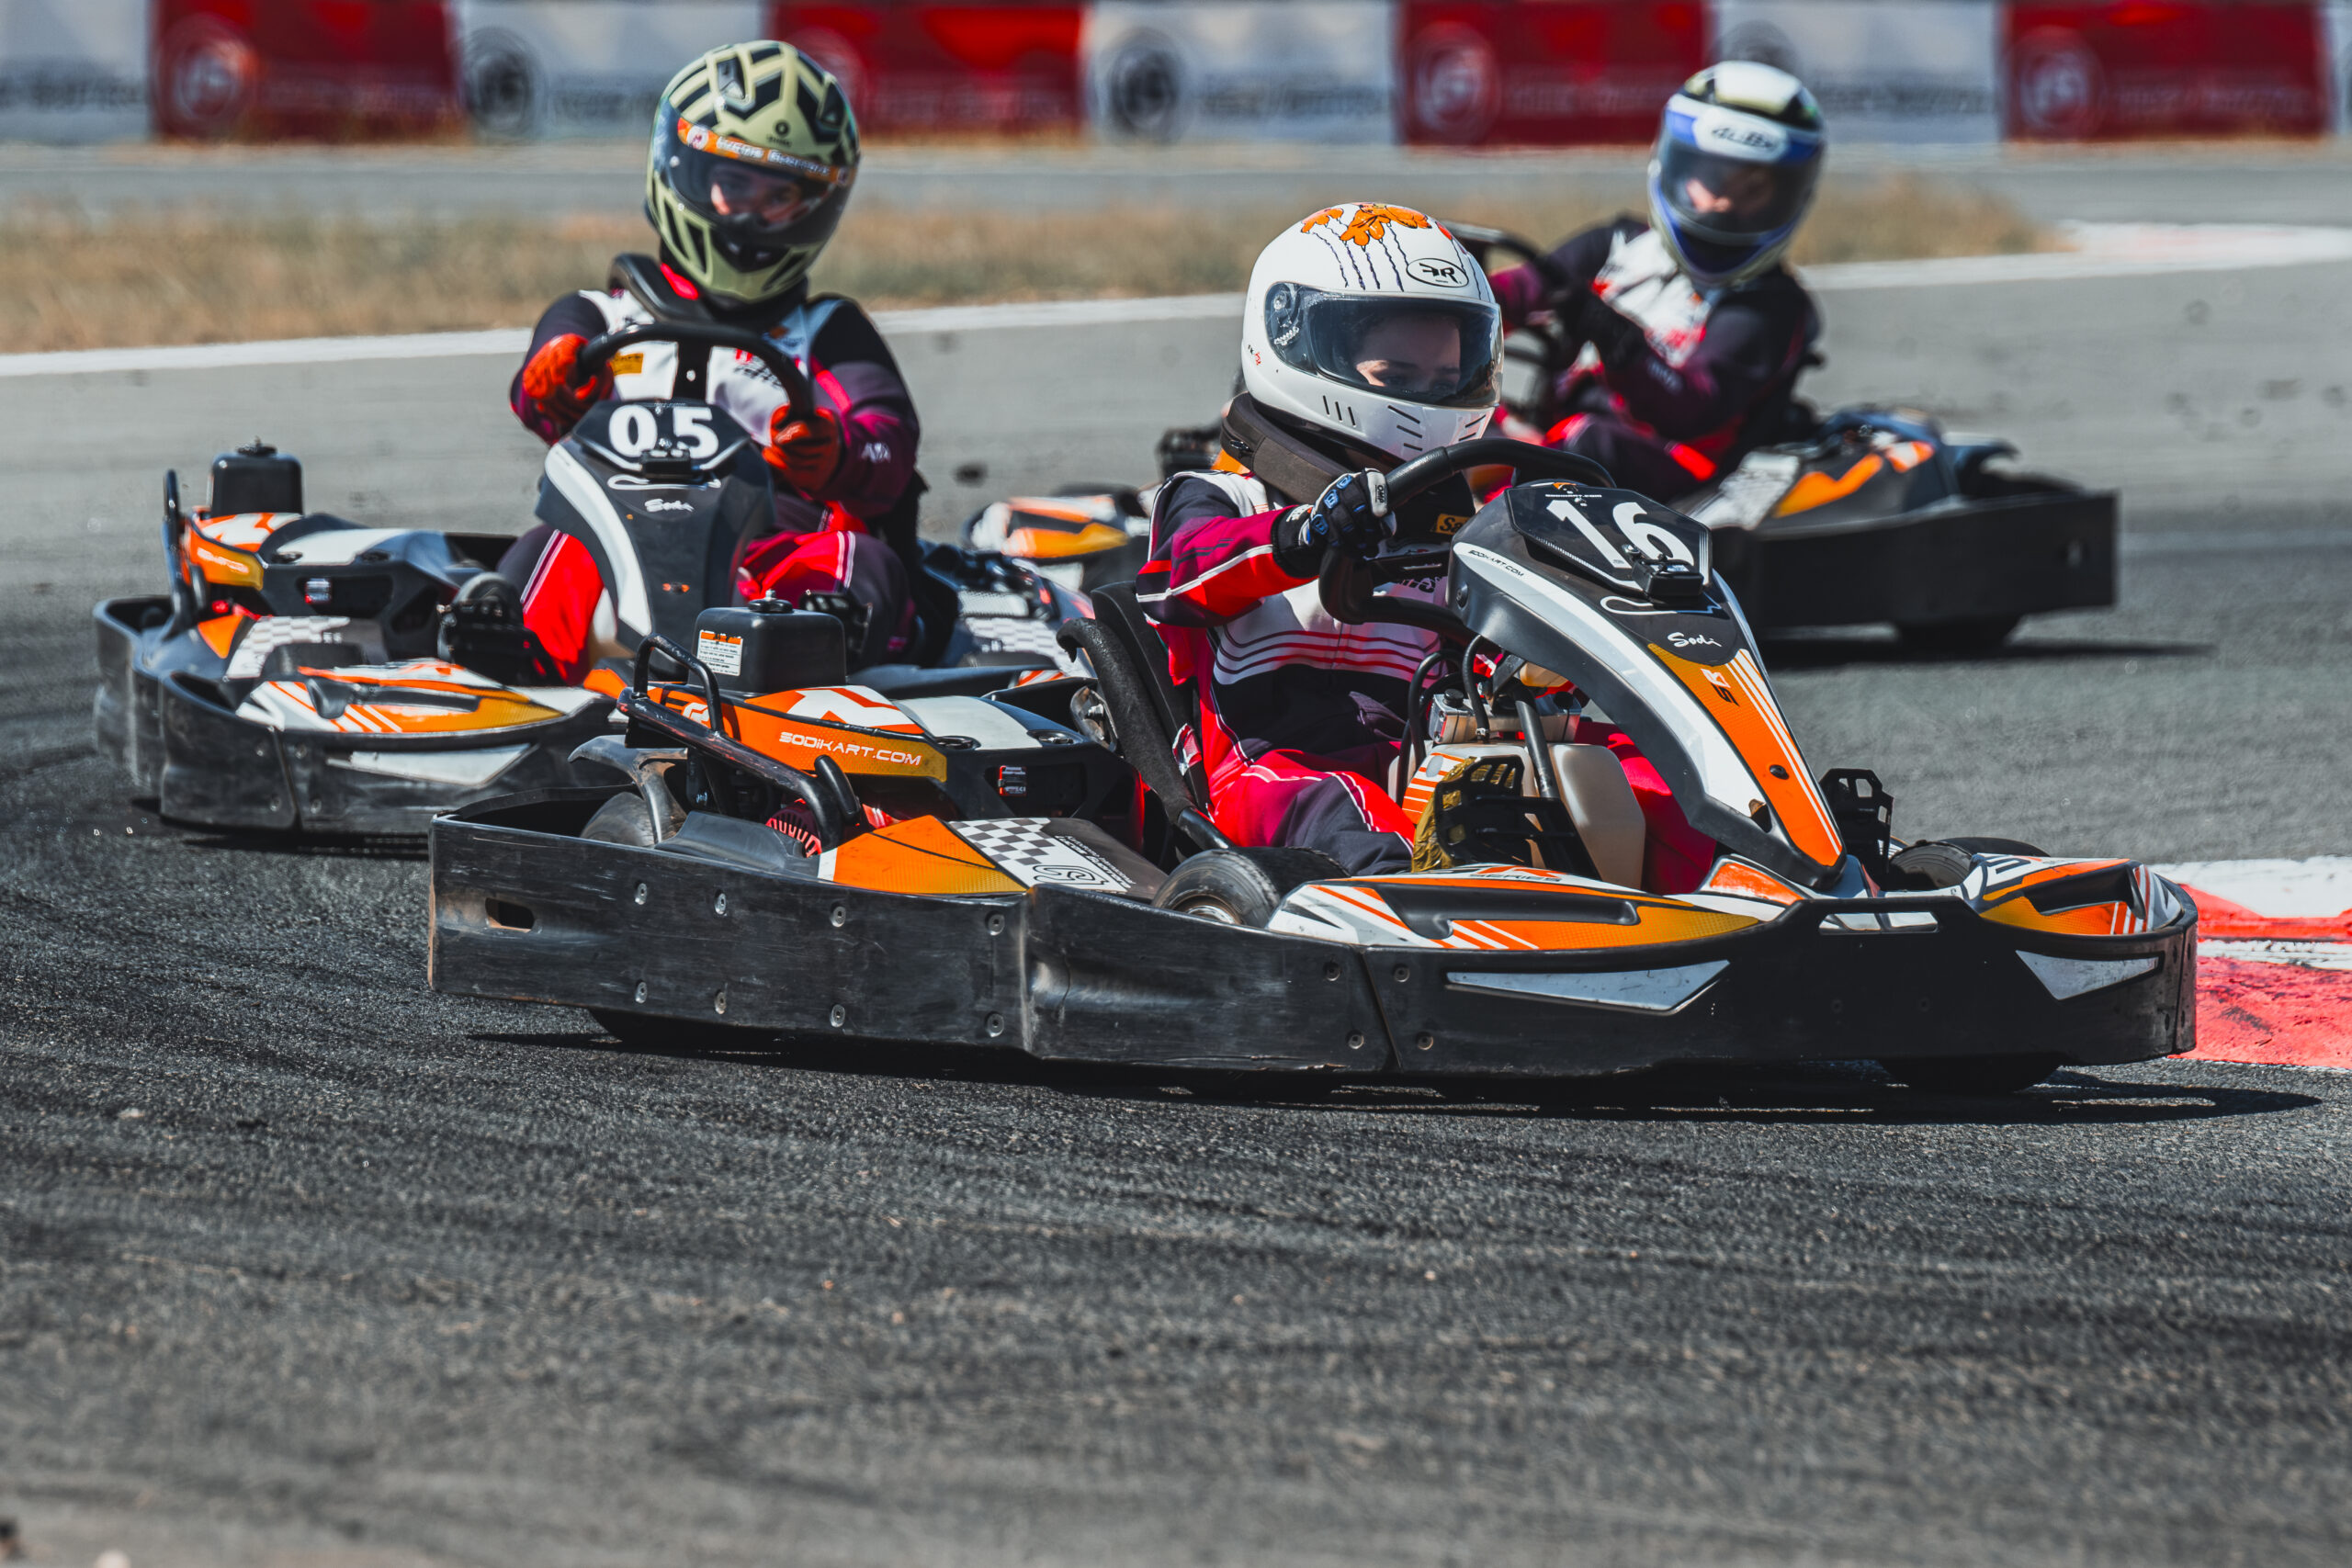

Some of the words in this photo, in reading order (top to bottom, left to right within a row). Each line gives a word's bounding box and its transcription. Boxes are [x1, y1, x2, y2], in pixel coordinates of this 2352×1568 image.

[609, 404, 718, 458] 05
[1546, 500, 1694, 573] 16
[1668, 632, 1723, 648] Sodi
